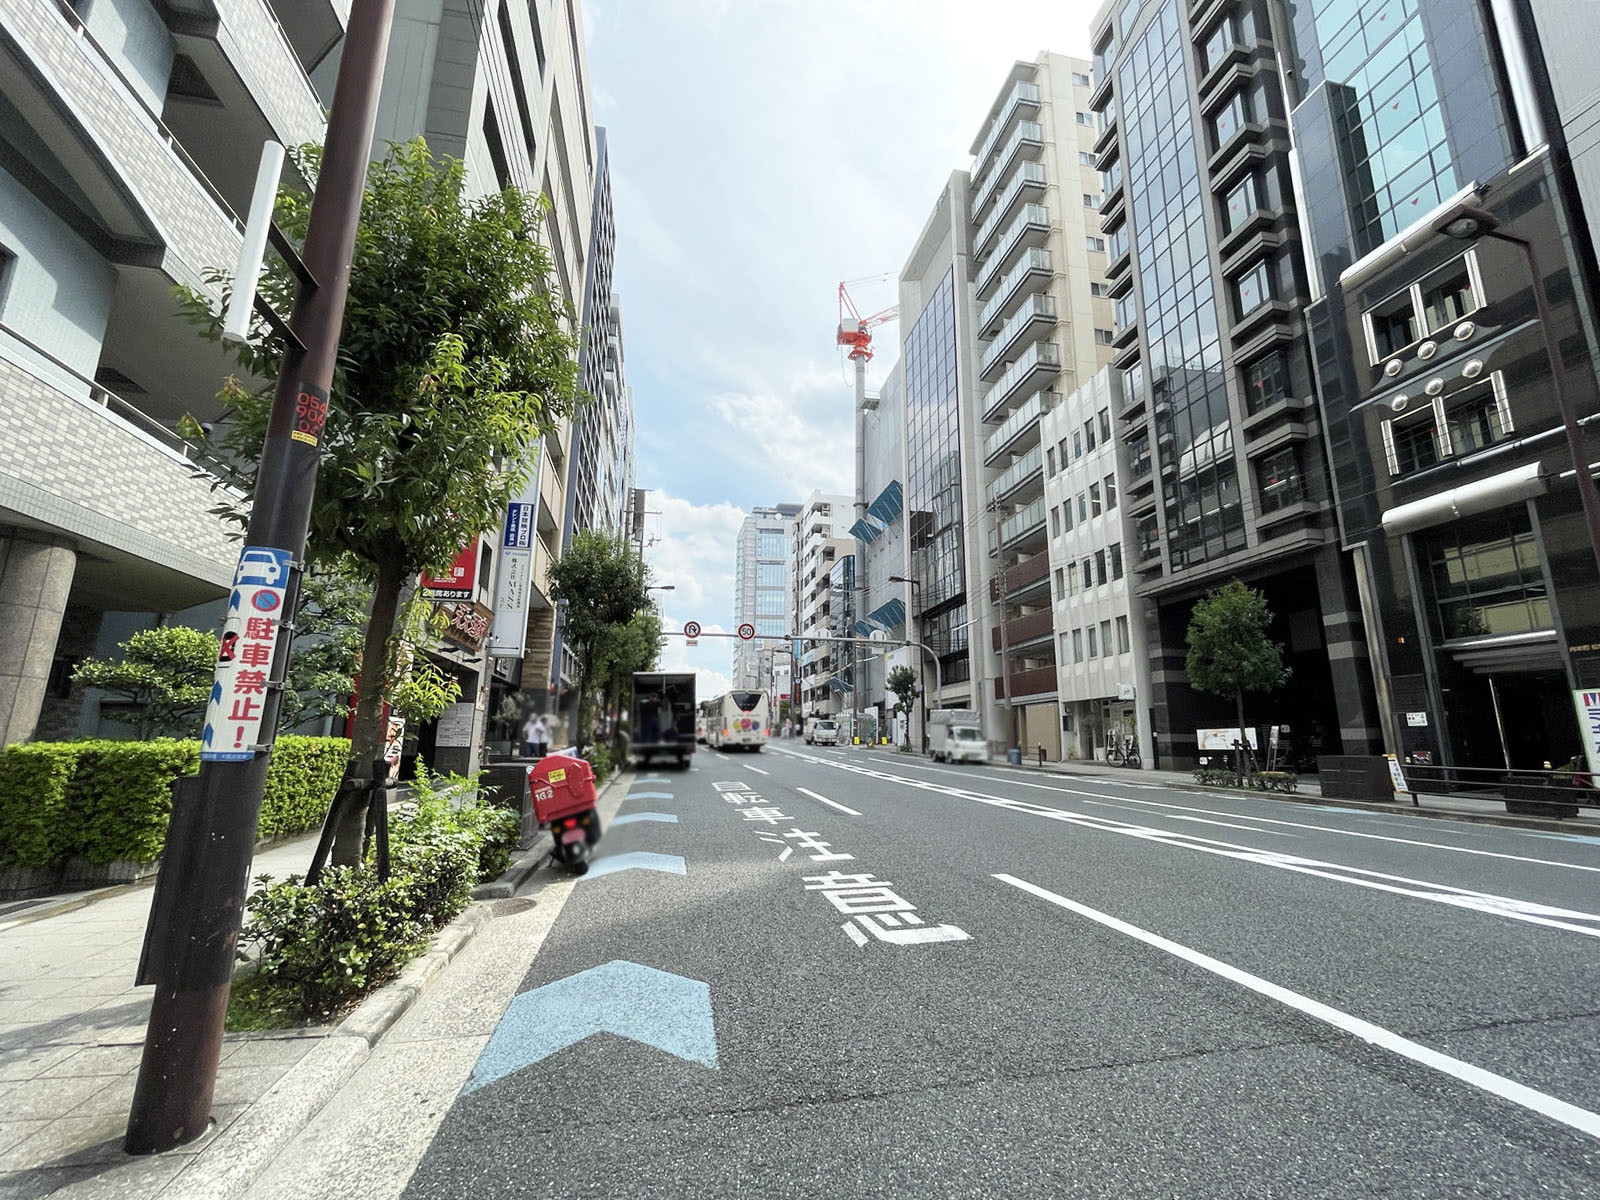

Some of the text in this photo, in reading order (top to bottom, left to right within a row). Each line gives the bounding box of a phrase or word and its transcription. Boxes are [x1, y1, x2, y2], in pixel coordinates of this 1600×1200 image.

[741, 627, 752, 636] 50
[711, 781, 975, 947] 自転車注意
